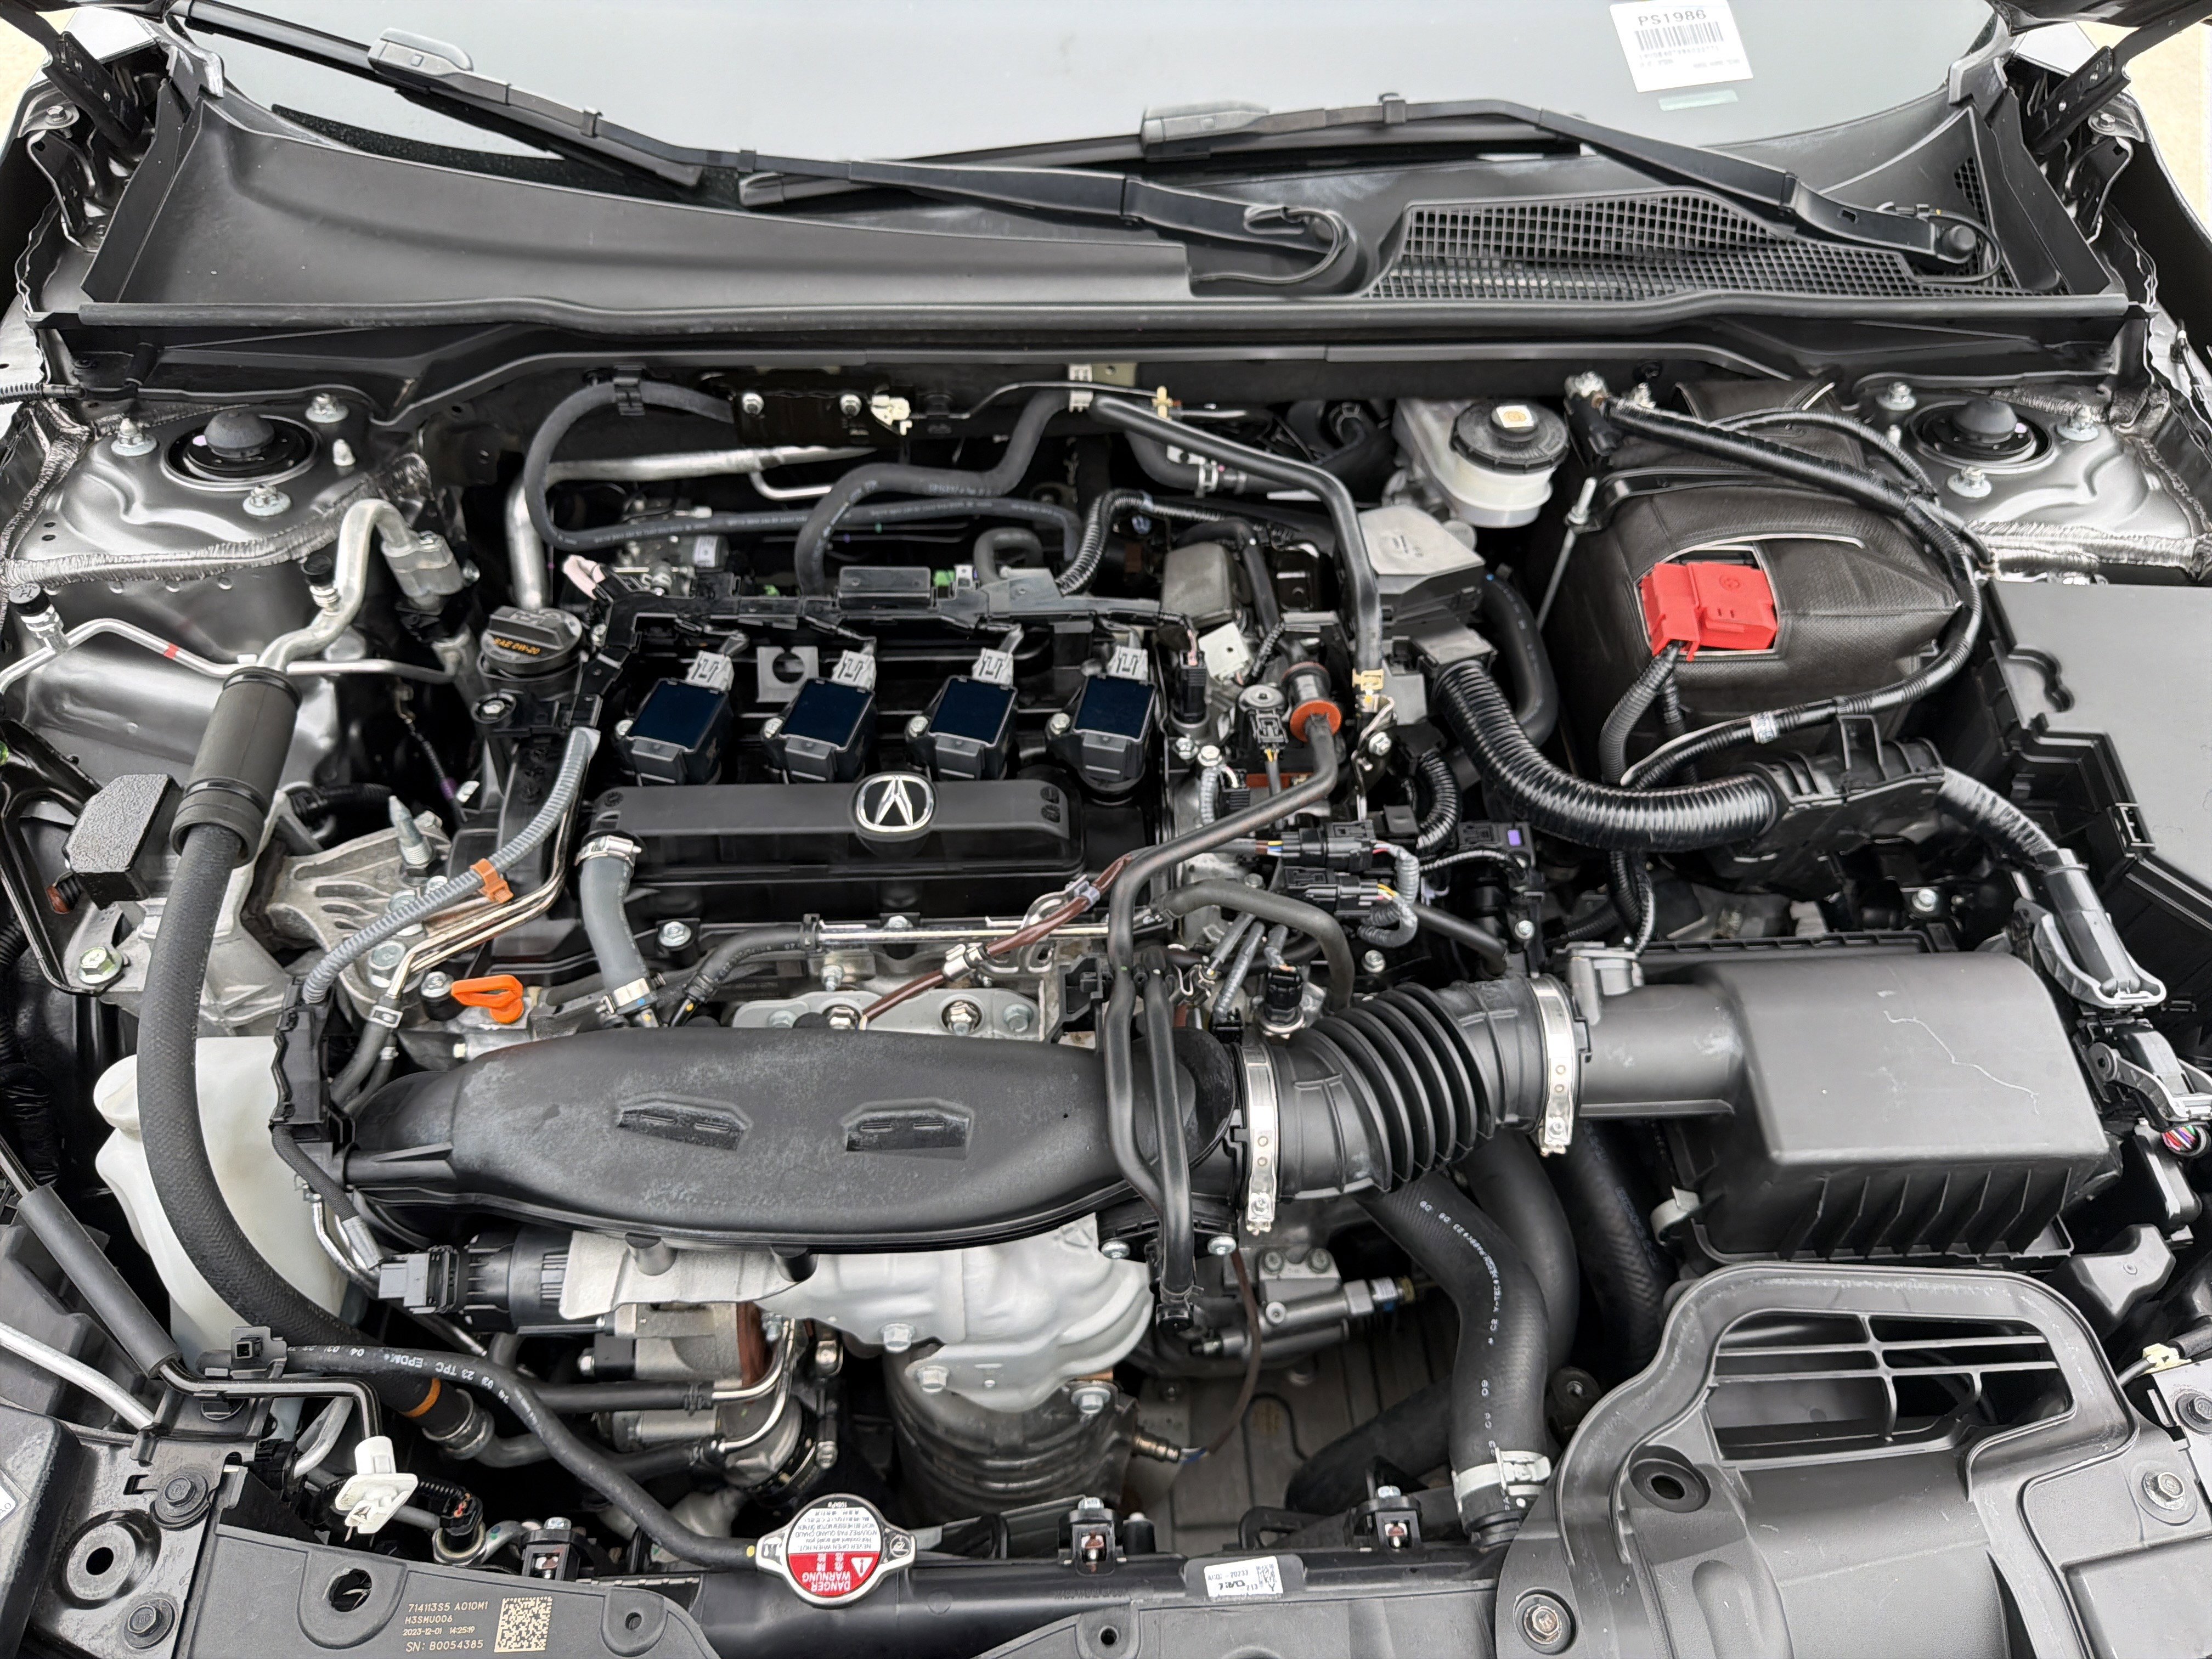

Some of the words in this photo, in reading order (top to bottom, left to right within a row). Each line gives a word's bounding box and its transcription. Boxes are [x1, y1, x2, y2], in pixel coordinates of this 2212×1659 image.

[1638, 10, 1706, 26] PS1986
[435, 1362, 457, 1376] TPC
[461, 1369, 475, 1381] 23
[802, 1571, 850, 1582] WARNUNG
[811, 1581, 850, 1592] DANGER
[408, 1602, 450, 1612] 714113S5
[454, 1601, 488, 1611] A010M1
[405, 1615, 453, 1624] H3SMU006
[402, 1627, 442, 1636] 2023-12-01
[449, 1626, 475, 1634] 14:25:19
[406, 1641, 426, 1652] SN:
[430, 1639, 484, 1651] B0054385
